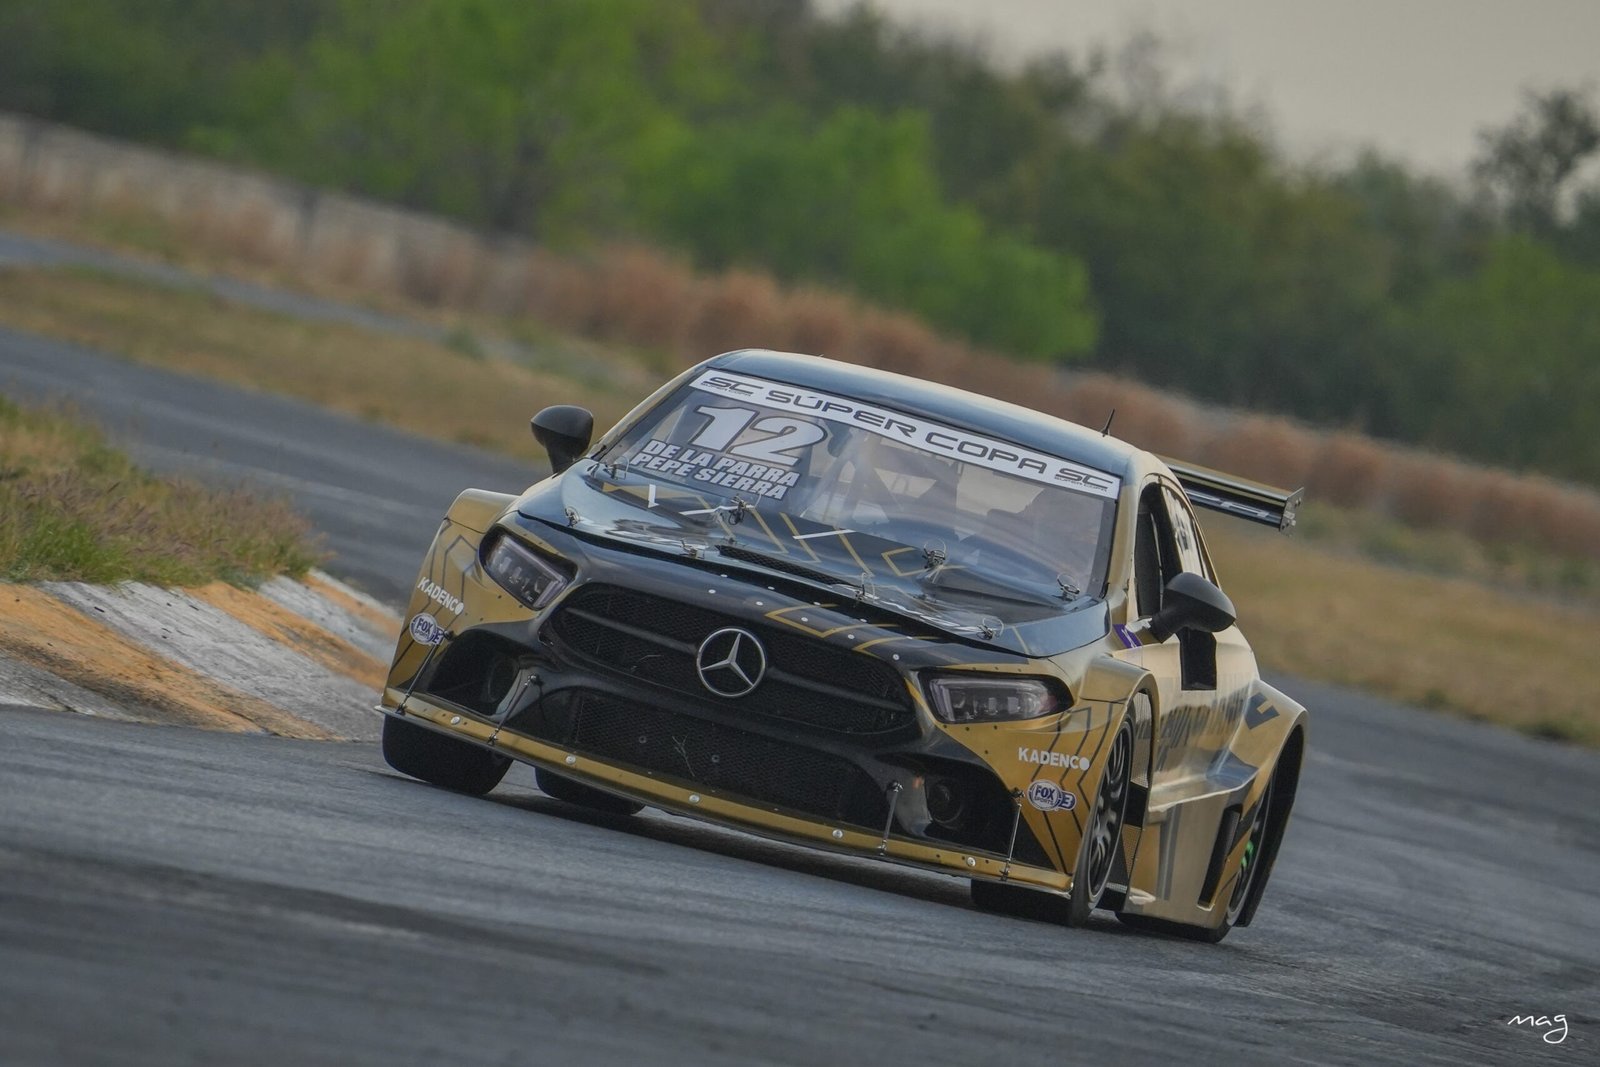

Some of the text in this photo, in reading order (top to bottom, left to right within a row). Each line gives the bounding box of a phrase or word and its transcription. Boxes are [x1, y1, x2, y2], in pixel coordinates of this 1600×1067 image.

[694, 405, 828, 467] 12
[701, 376, 764, 395] SC
[925, 432, 1047, 474] COPA
[1055, 468, 1113, 489] SC
[630, 452, 788, 500] PEPE SIERRA
[642, 439, 800, 488] DE LA PARRA
[416, 617, 433, 635] FOX
[1035, 784, 1055, 801] FOX
